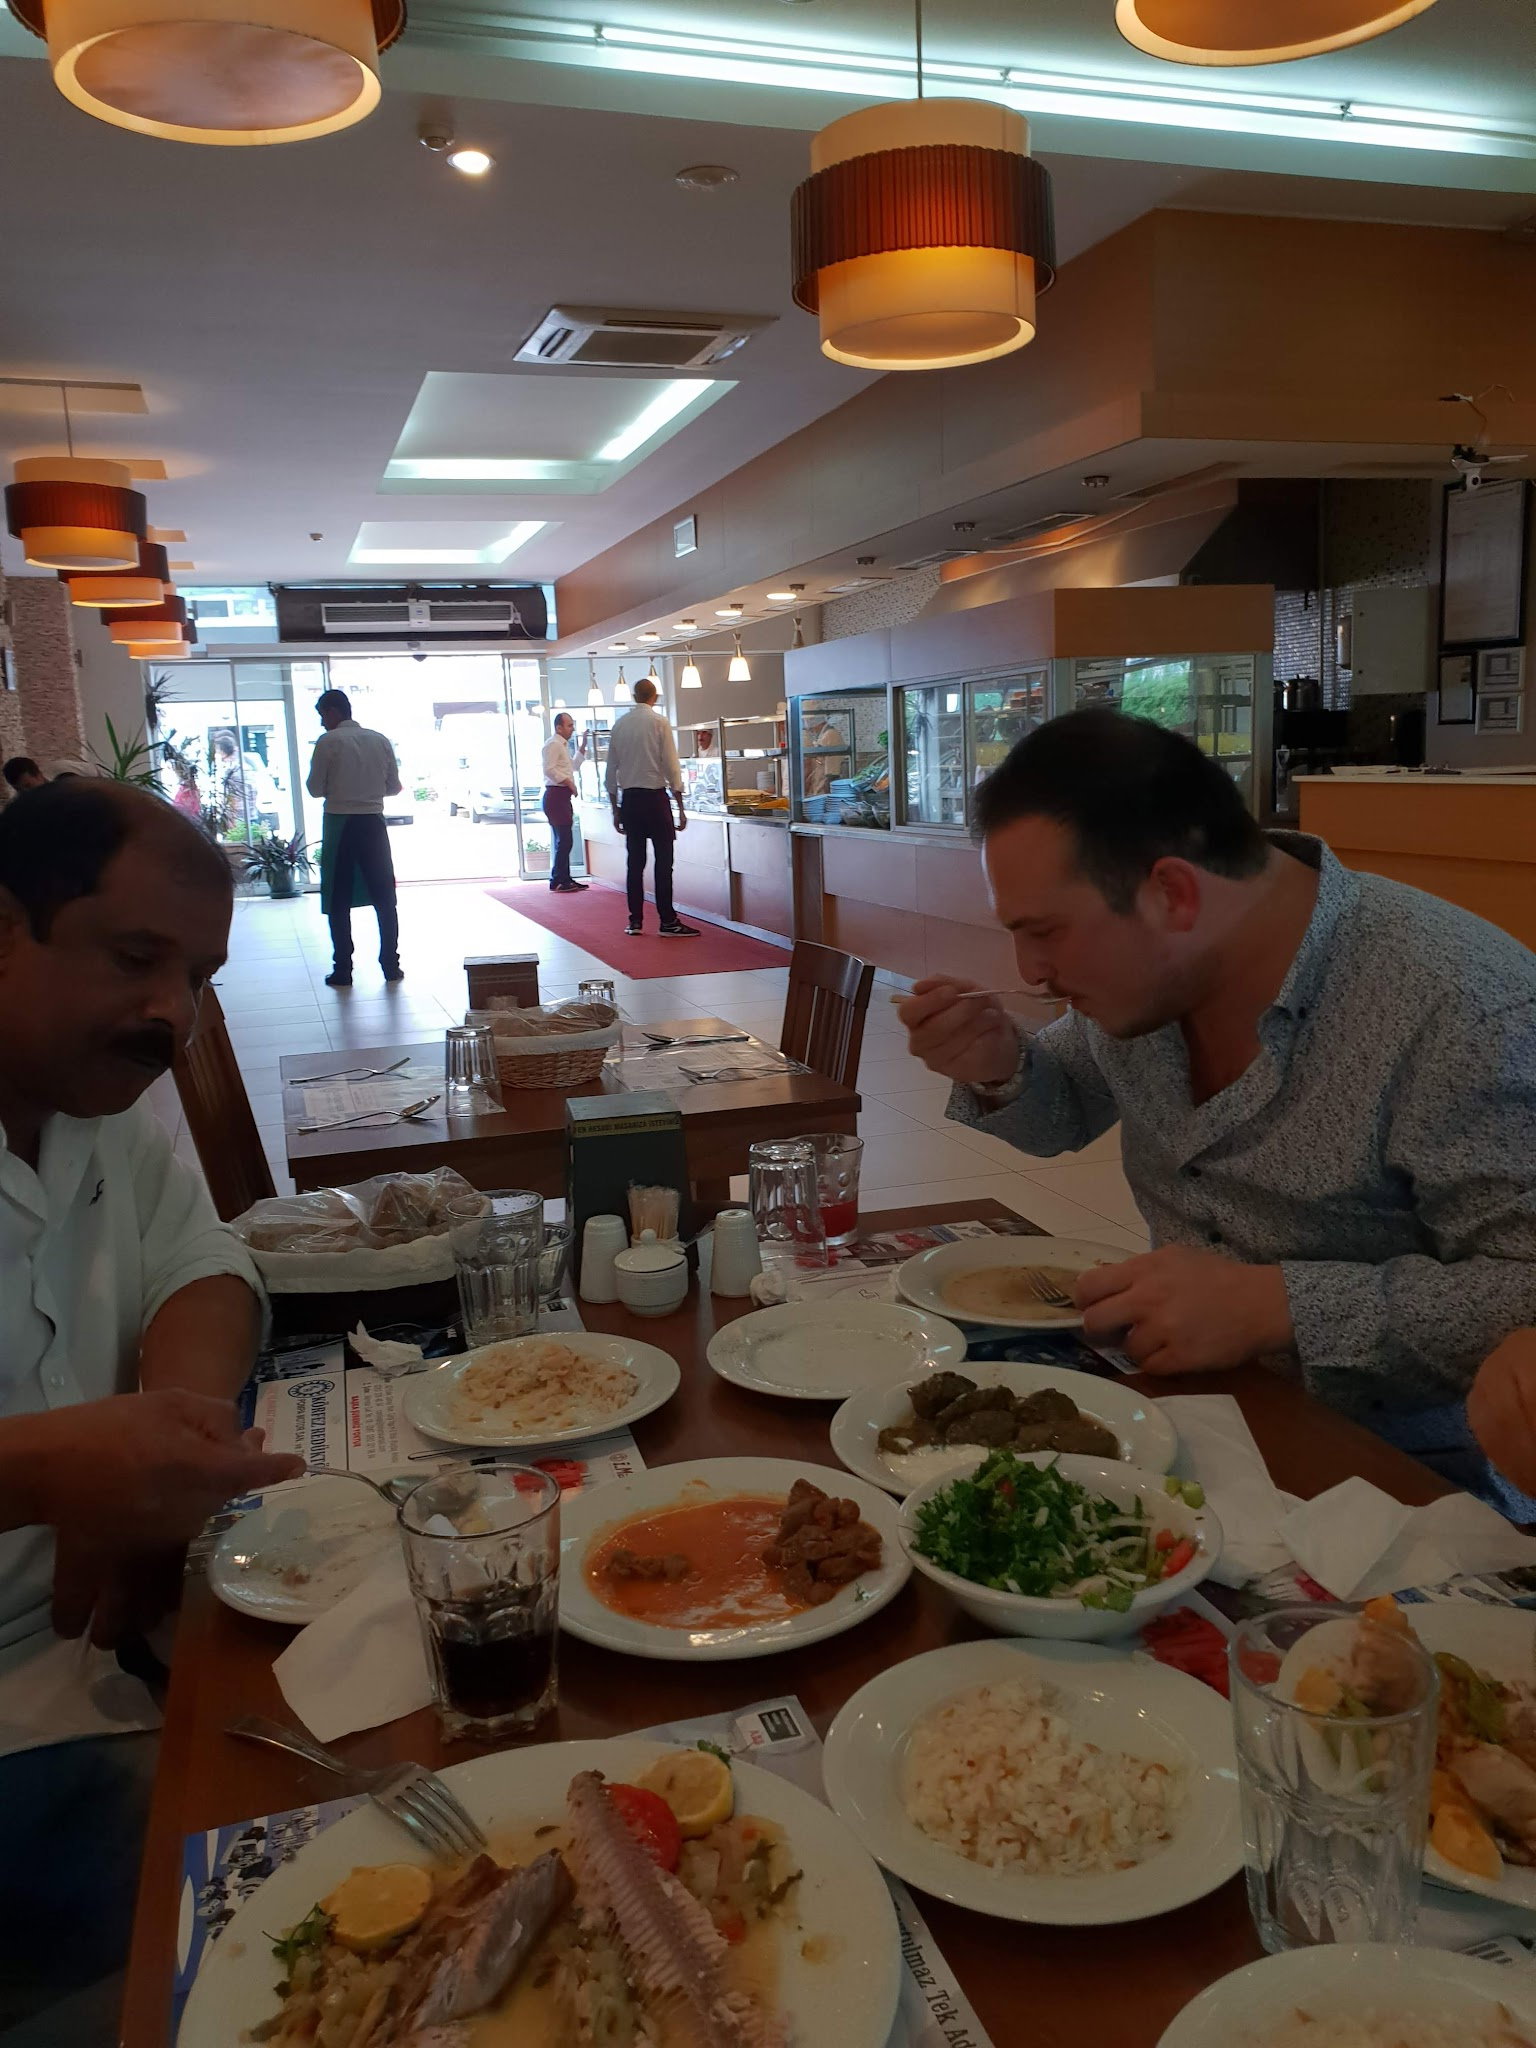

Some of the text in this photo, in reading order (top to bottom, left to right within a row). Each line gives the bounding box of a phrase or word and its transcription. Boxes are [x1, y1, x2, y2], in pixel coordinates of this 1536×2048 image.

[310, 1396, 330, 1477] KÖRFEZ REDÜKTÖ
[926, 1989, 958, 2026] Tek
